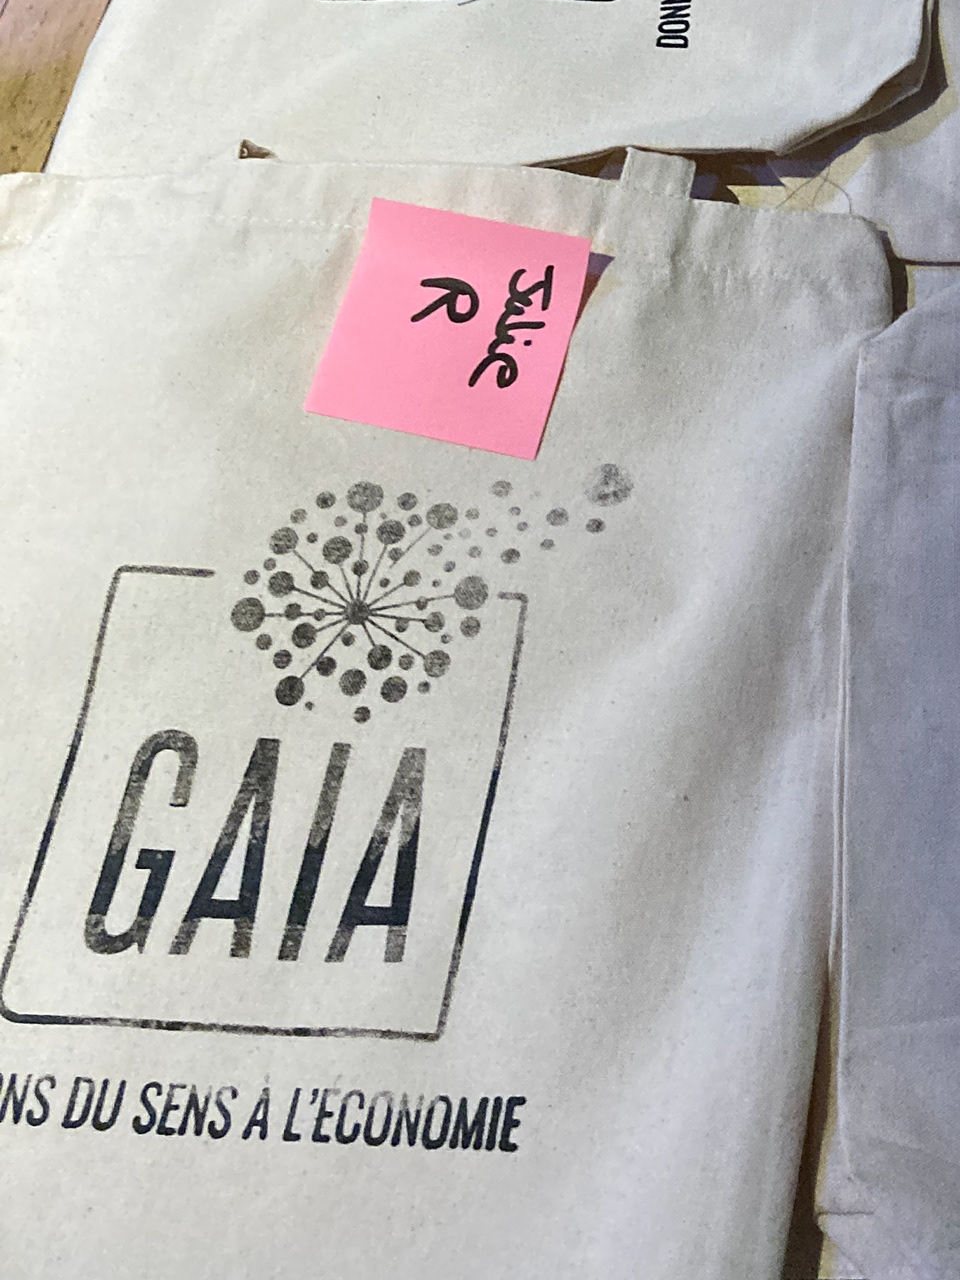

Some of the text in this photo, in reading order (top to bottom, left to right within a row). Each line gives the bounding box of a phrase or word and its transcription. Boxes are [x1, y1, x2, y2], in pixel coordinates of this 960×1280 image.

[410, 277, 479, 323] R
[83, 728, 427, 963] GAIA
[61, 1075, 127, 1131] DU
[132, 1080, 238, 1140] SENS
